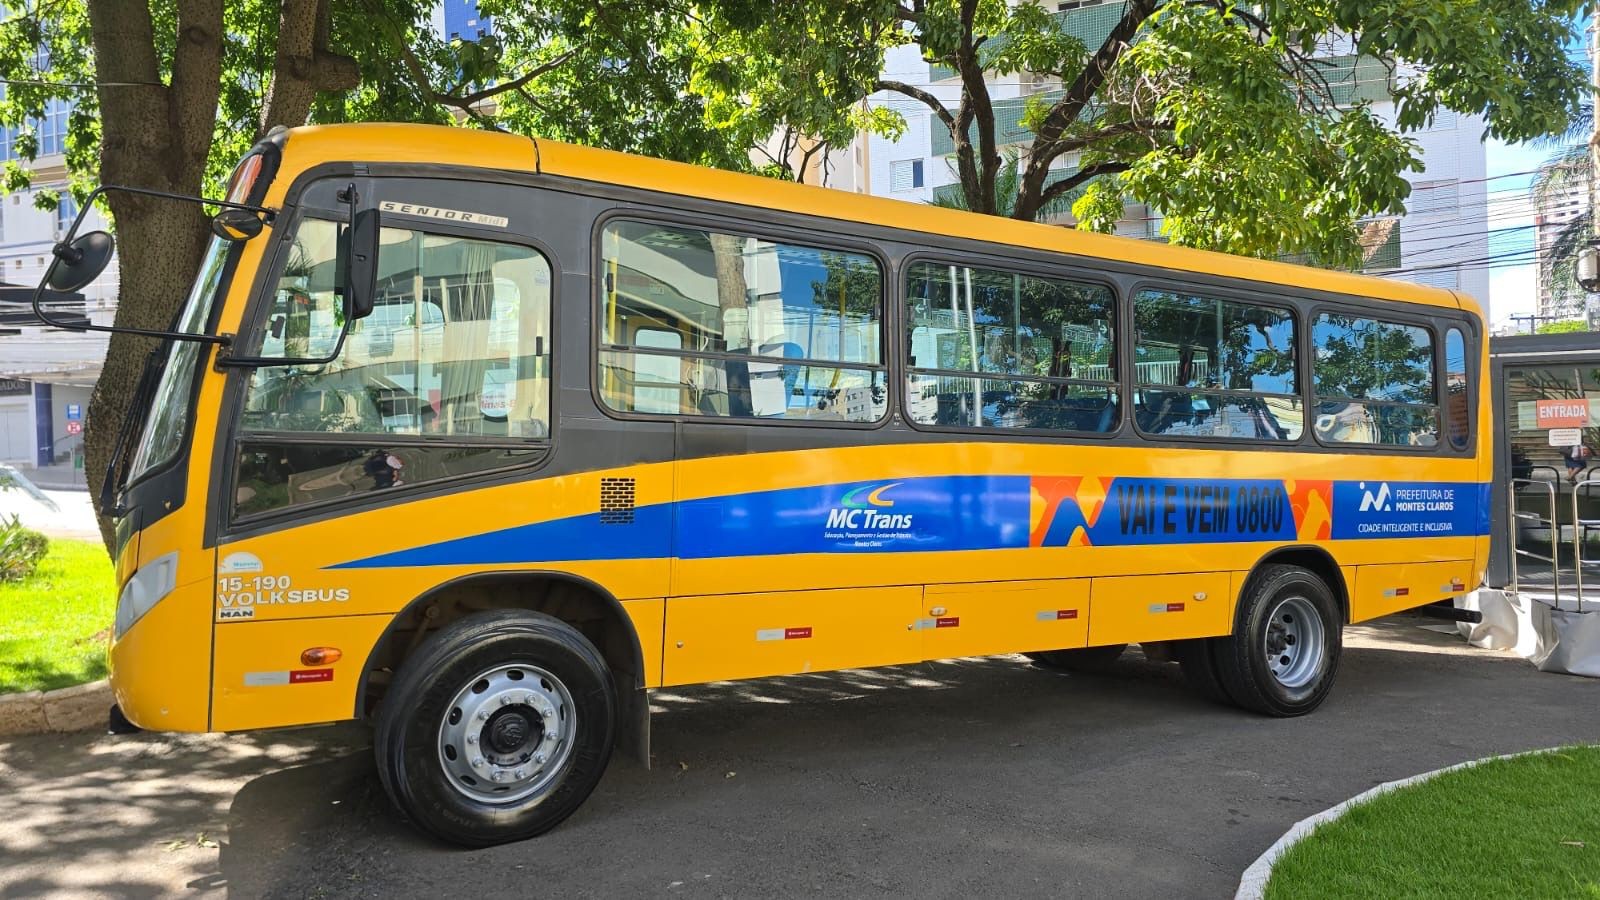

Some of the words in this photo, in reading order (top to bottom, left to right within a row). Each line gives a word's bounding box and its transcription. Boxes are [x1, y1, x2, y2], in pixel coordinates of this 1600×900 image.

[384, 203, 472, 221] SENIOR
[1540, 405, 1586, 419] ENTRADA
[1396, 490, 1442, 500] PREFEITURA
[1444, 490, 1454, 500] DE
[1118, 484, 1155, 535] VAI
[1163, 485, 1177, 534] E
[1184, 486, 1229, 534] VEM
[1236, 486, 1283, 533] 0800
[1396, 502, 1425, 511] MONTES
[1426, 502, 1454, 511] CLAROS
[826, 508, 862, 529] MC
[863, 509, 913, 529] Trans
[1358, 523, 1381, 532] CIDADE
[1382, 523, 1418, 532] INTELIGENTE
[1420, 523, 1424, 531] E
[1425, 522, 1453, 531] INCLUSIVA
[219, 575, 291, 592] 15-190
[219, 588, 349, 607] VOLKSBUS
[220, 610, 253, 618] MAN
